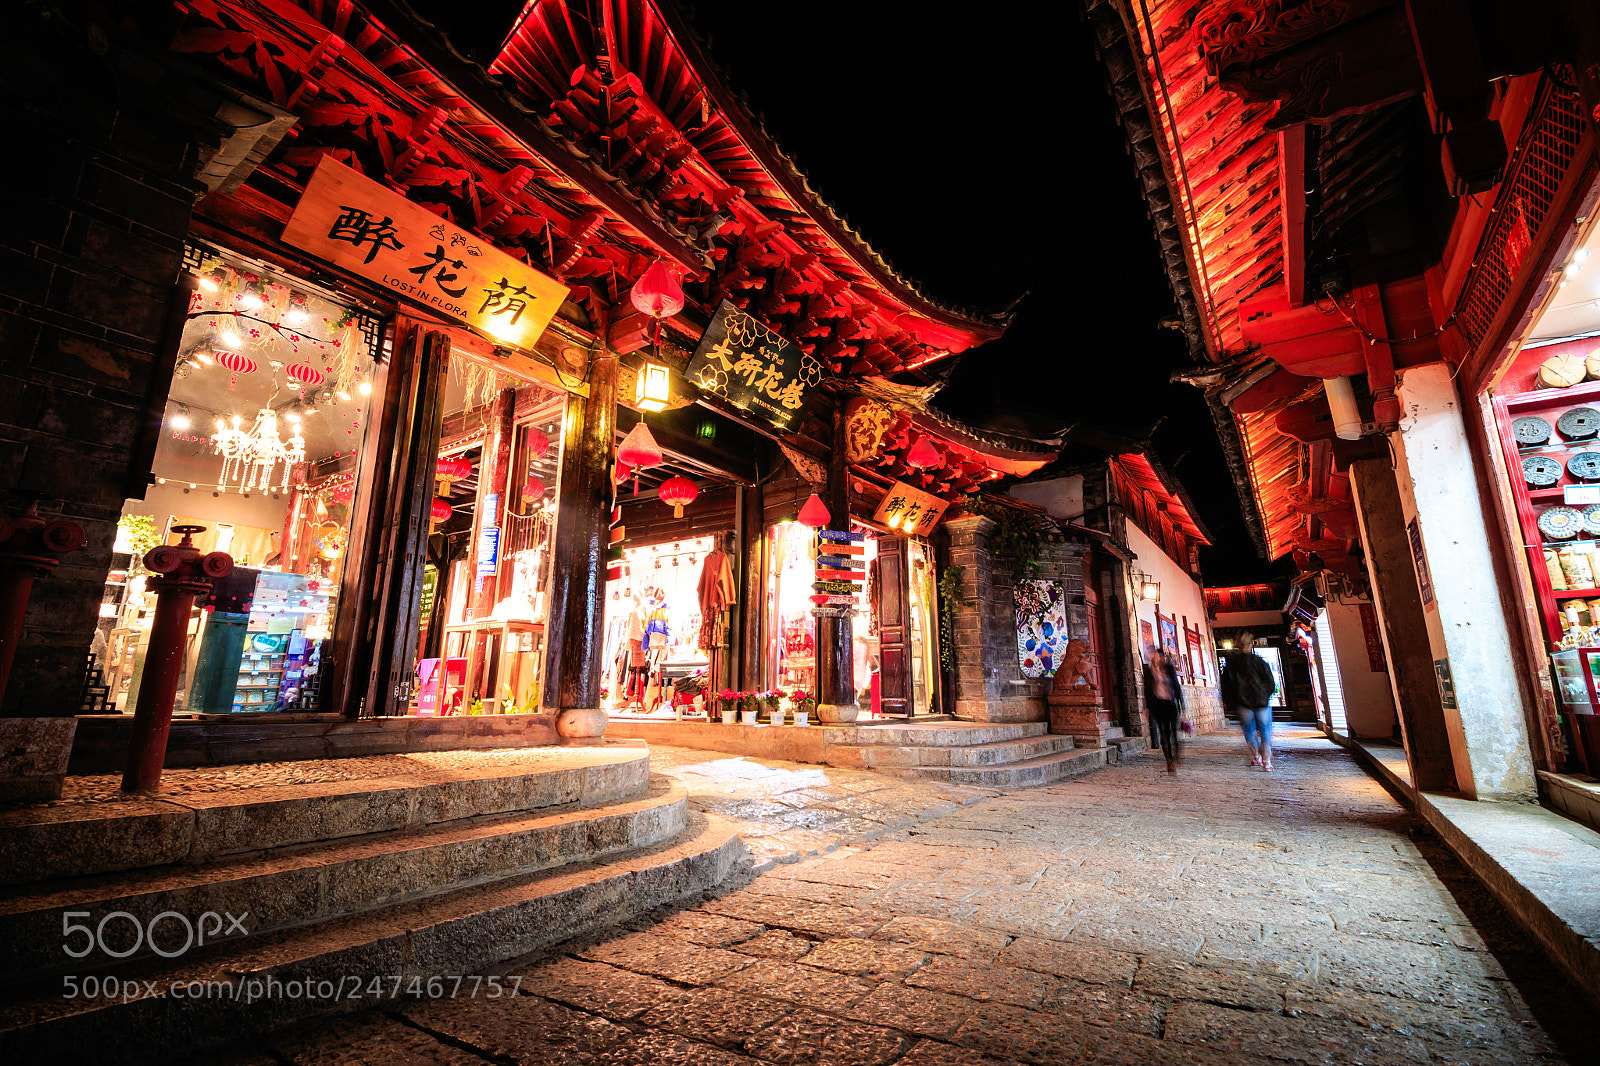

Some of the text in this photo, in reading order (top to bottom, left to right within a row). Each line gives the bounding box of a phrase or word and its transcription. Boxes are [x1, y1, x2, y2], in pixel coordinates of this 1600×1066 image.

[328, 205, 537, 325] 醉花荫
[382, 274, 467, 318] LOST IN FLORA
[705, 338, 805, 410] 大研花巷
[172, 432, 216, 446] HAPPY
